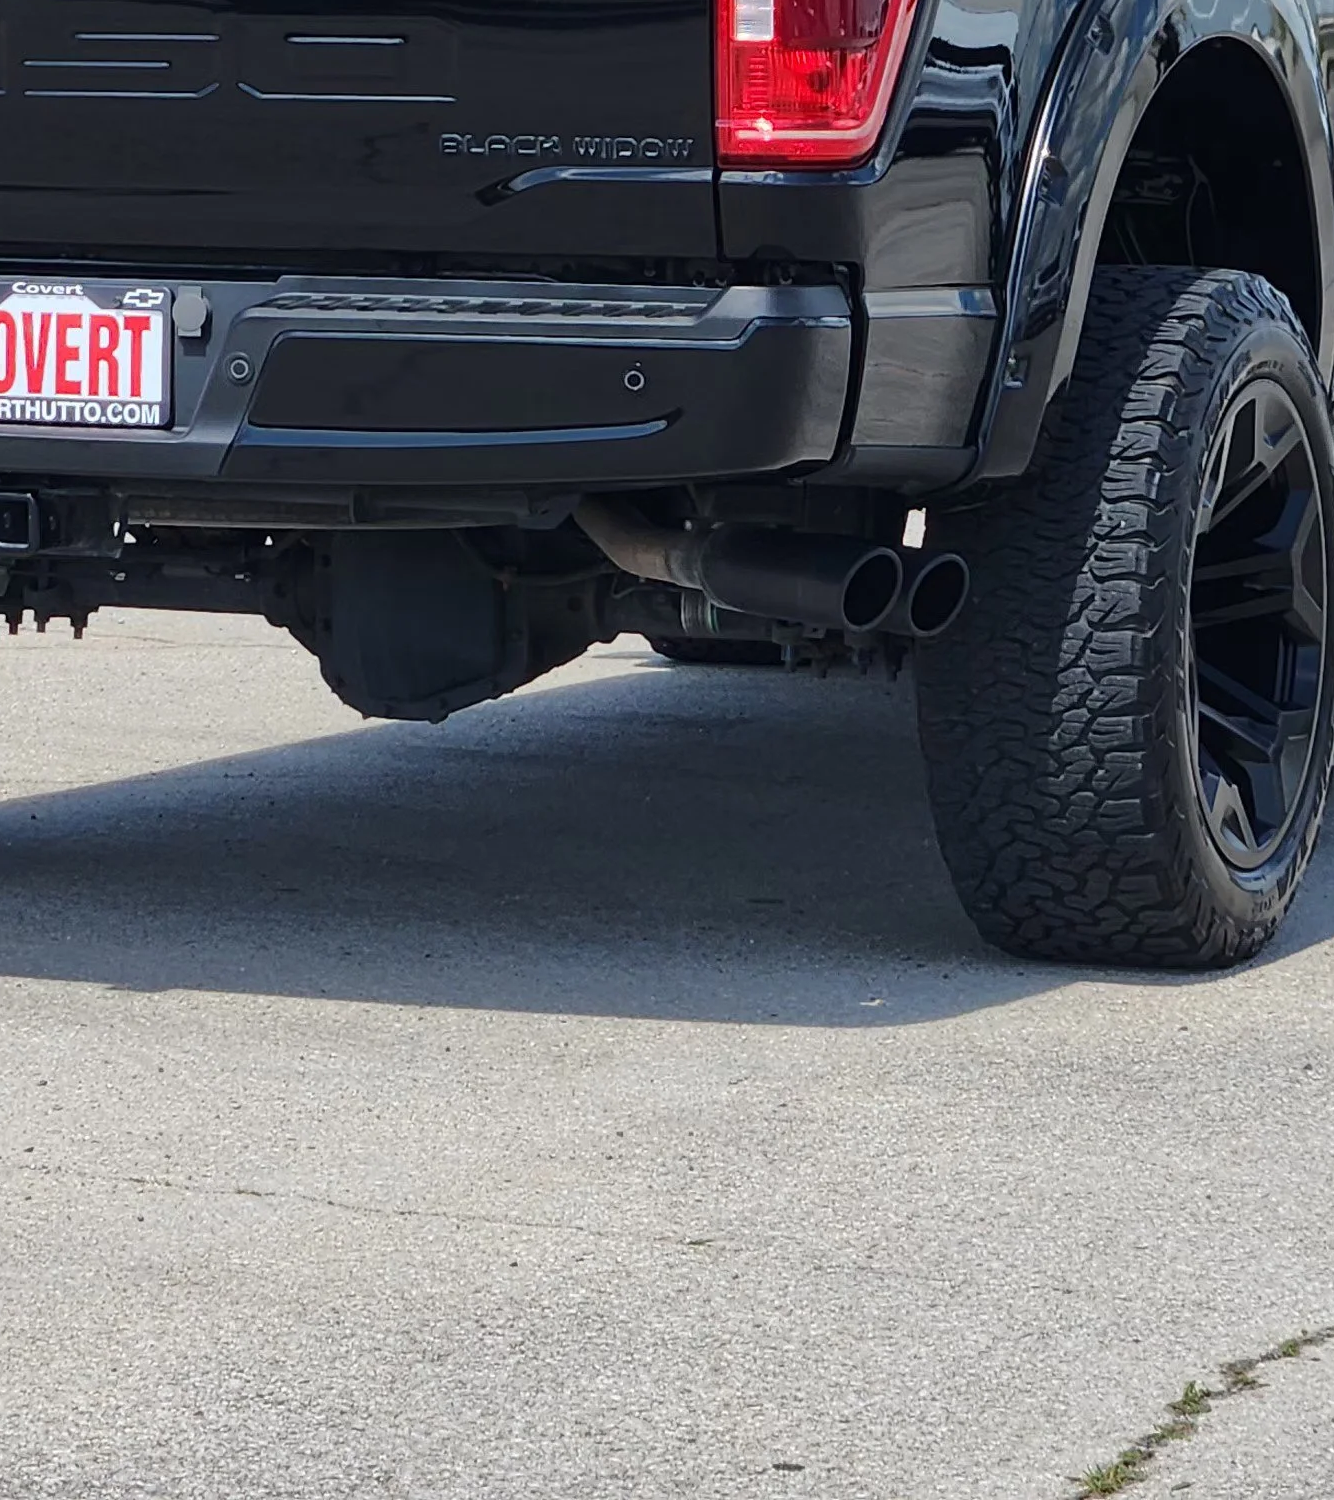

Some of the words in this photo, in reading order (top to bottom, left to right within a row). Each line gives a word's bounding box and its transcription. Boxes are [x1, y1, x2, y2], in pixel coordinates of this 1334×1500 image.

[440, 133, 562, 156] BLACK
[573, 136, 694, 158] WIDOW
[12, 282, 83, 295] Covert
